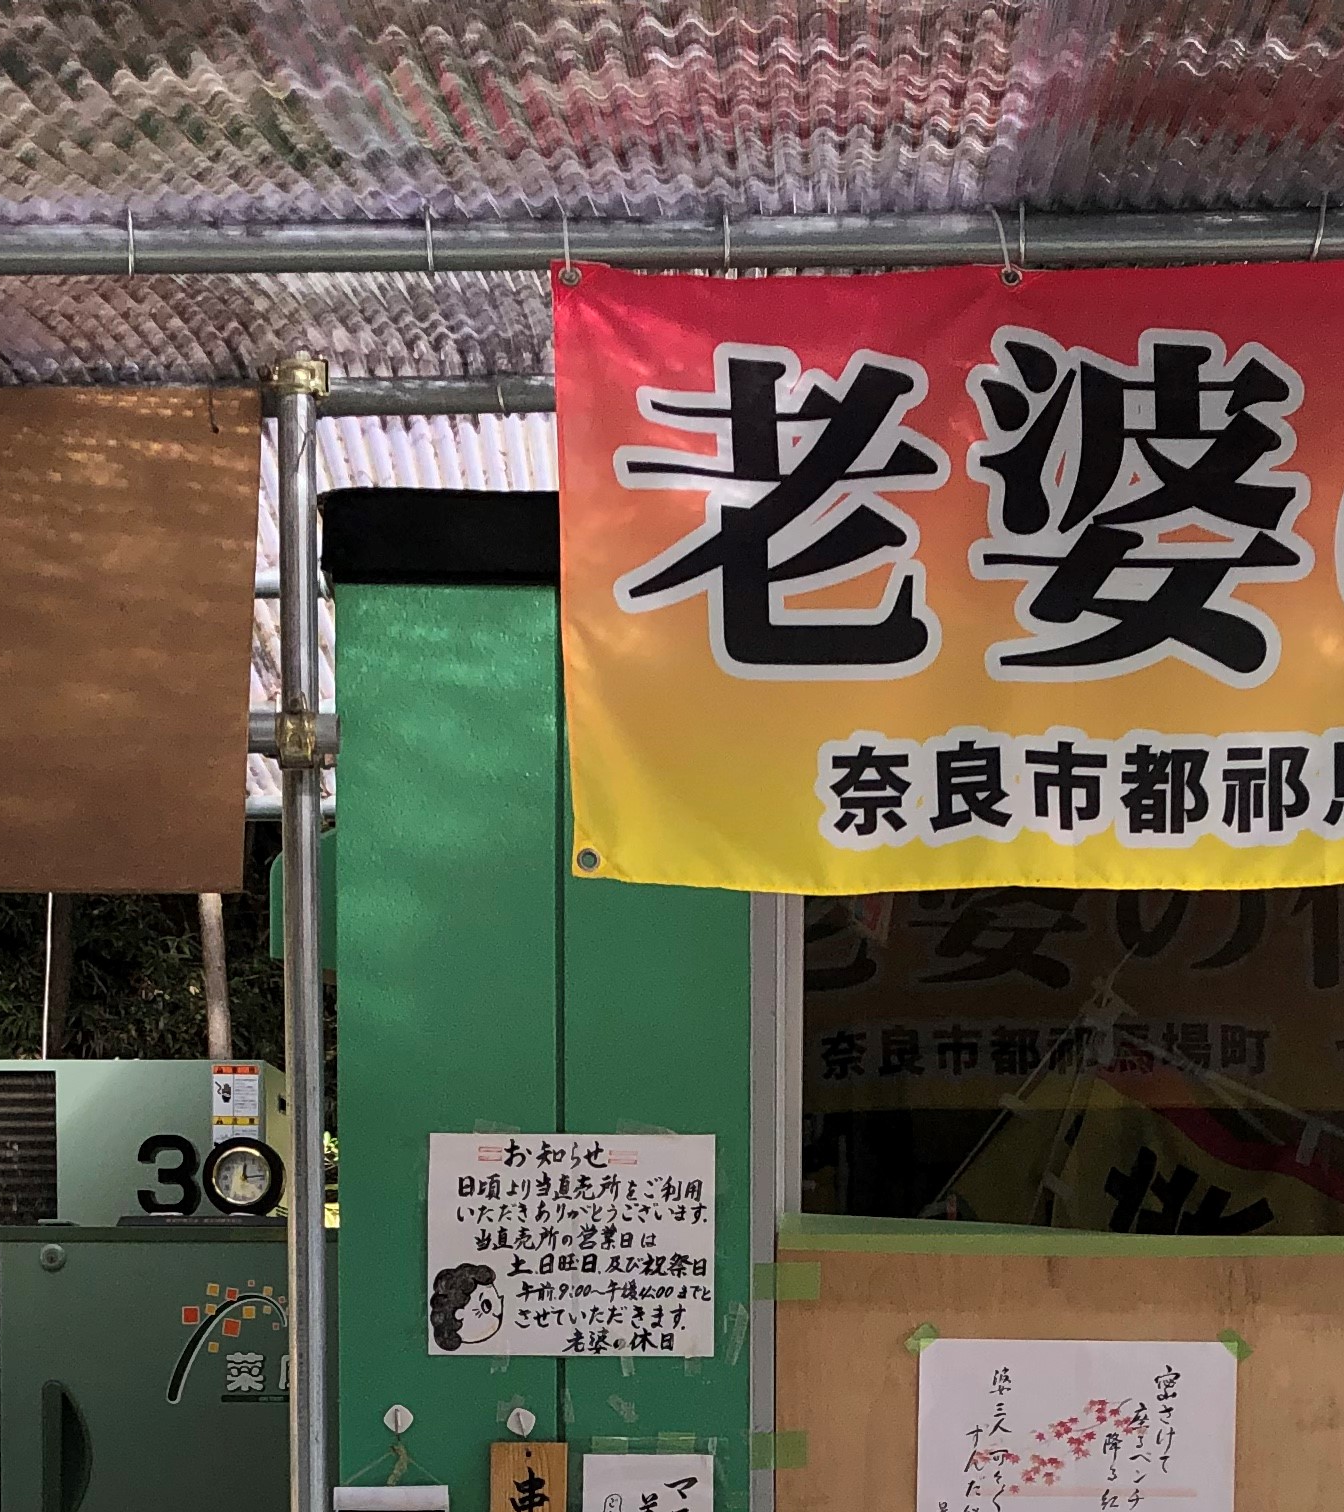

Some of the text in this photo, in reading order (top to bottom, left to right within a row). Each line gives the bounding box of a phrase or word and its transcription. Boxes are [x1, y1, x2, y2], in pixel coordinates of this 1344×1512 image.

[503, 1139, 608, 1169] お知らせ
[473, 1223, 657, 1251] 当直売所の営業日は
[563, 1329, 675, 1354] 老婆の休日
